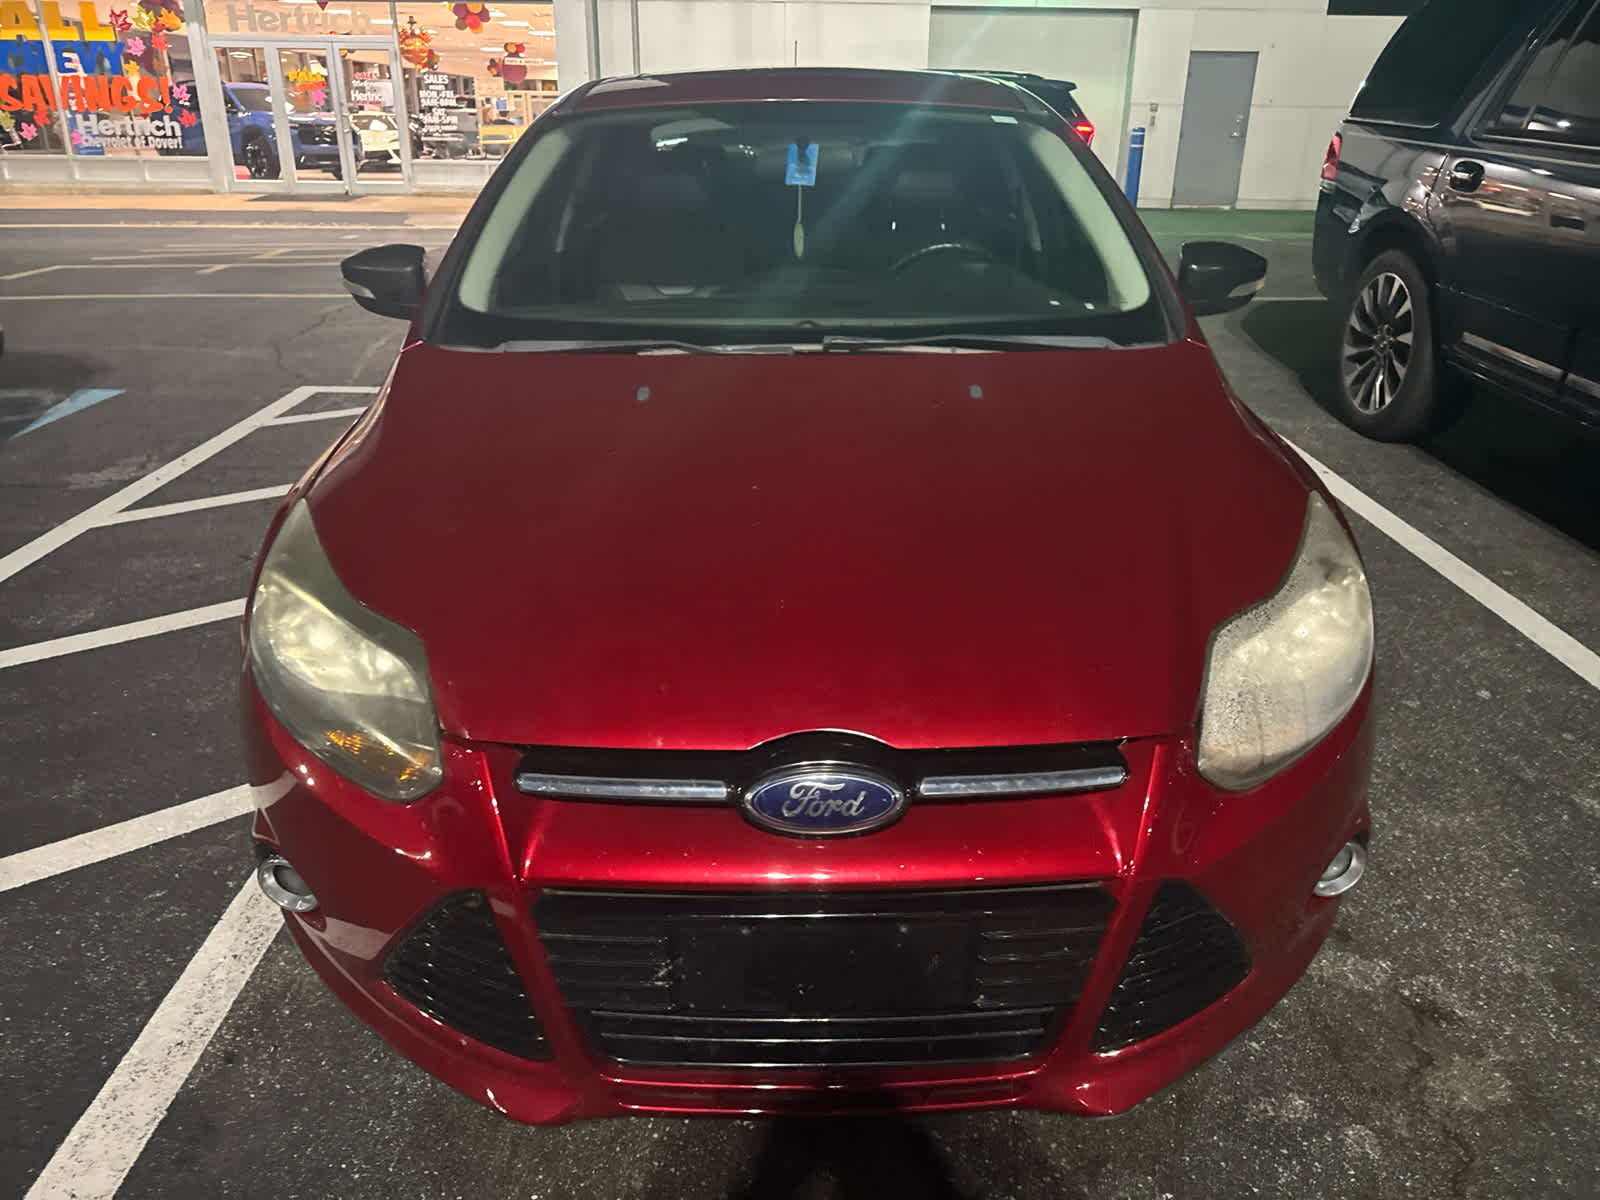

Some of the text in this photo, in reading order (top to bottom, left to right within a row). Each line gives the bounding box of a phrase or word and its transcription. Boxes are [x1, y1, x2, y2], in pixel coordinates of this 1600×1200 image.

[0, 1, 116, 41] ALL
[226, 4, 376, 33] Hertrich
[0, 40, 125, 75] CHEVY
[0, 74, 173, 114] SAVINGS!
[423, 74, 449, 84] SALES
[75, 114, 183, 137] Hertrich
[147, 136, 183, 149] Dover!
[781, 781, 866, 817] Ford
